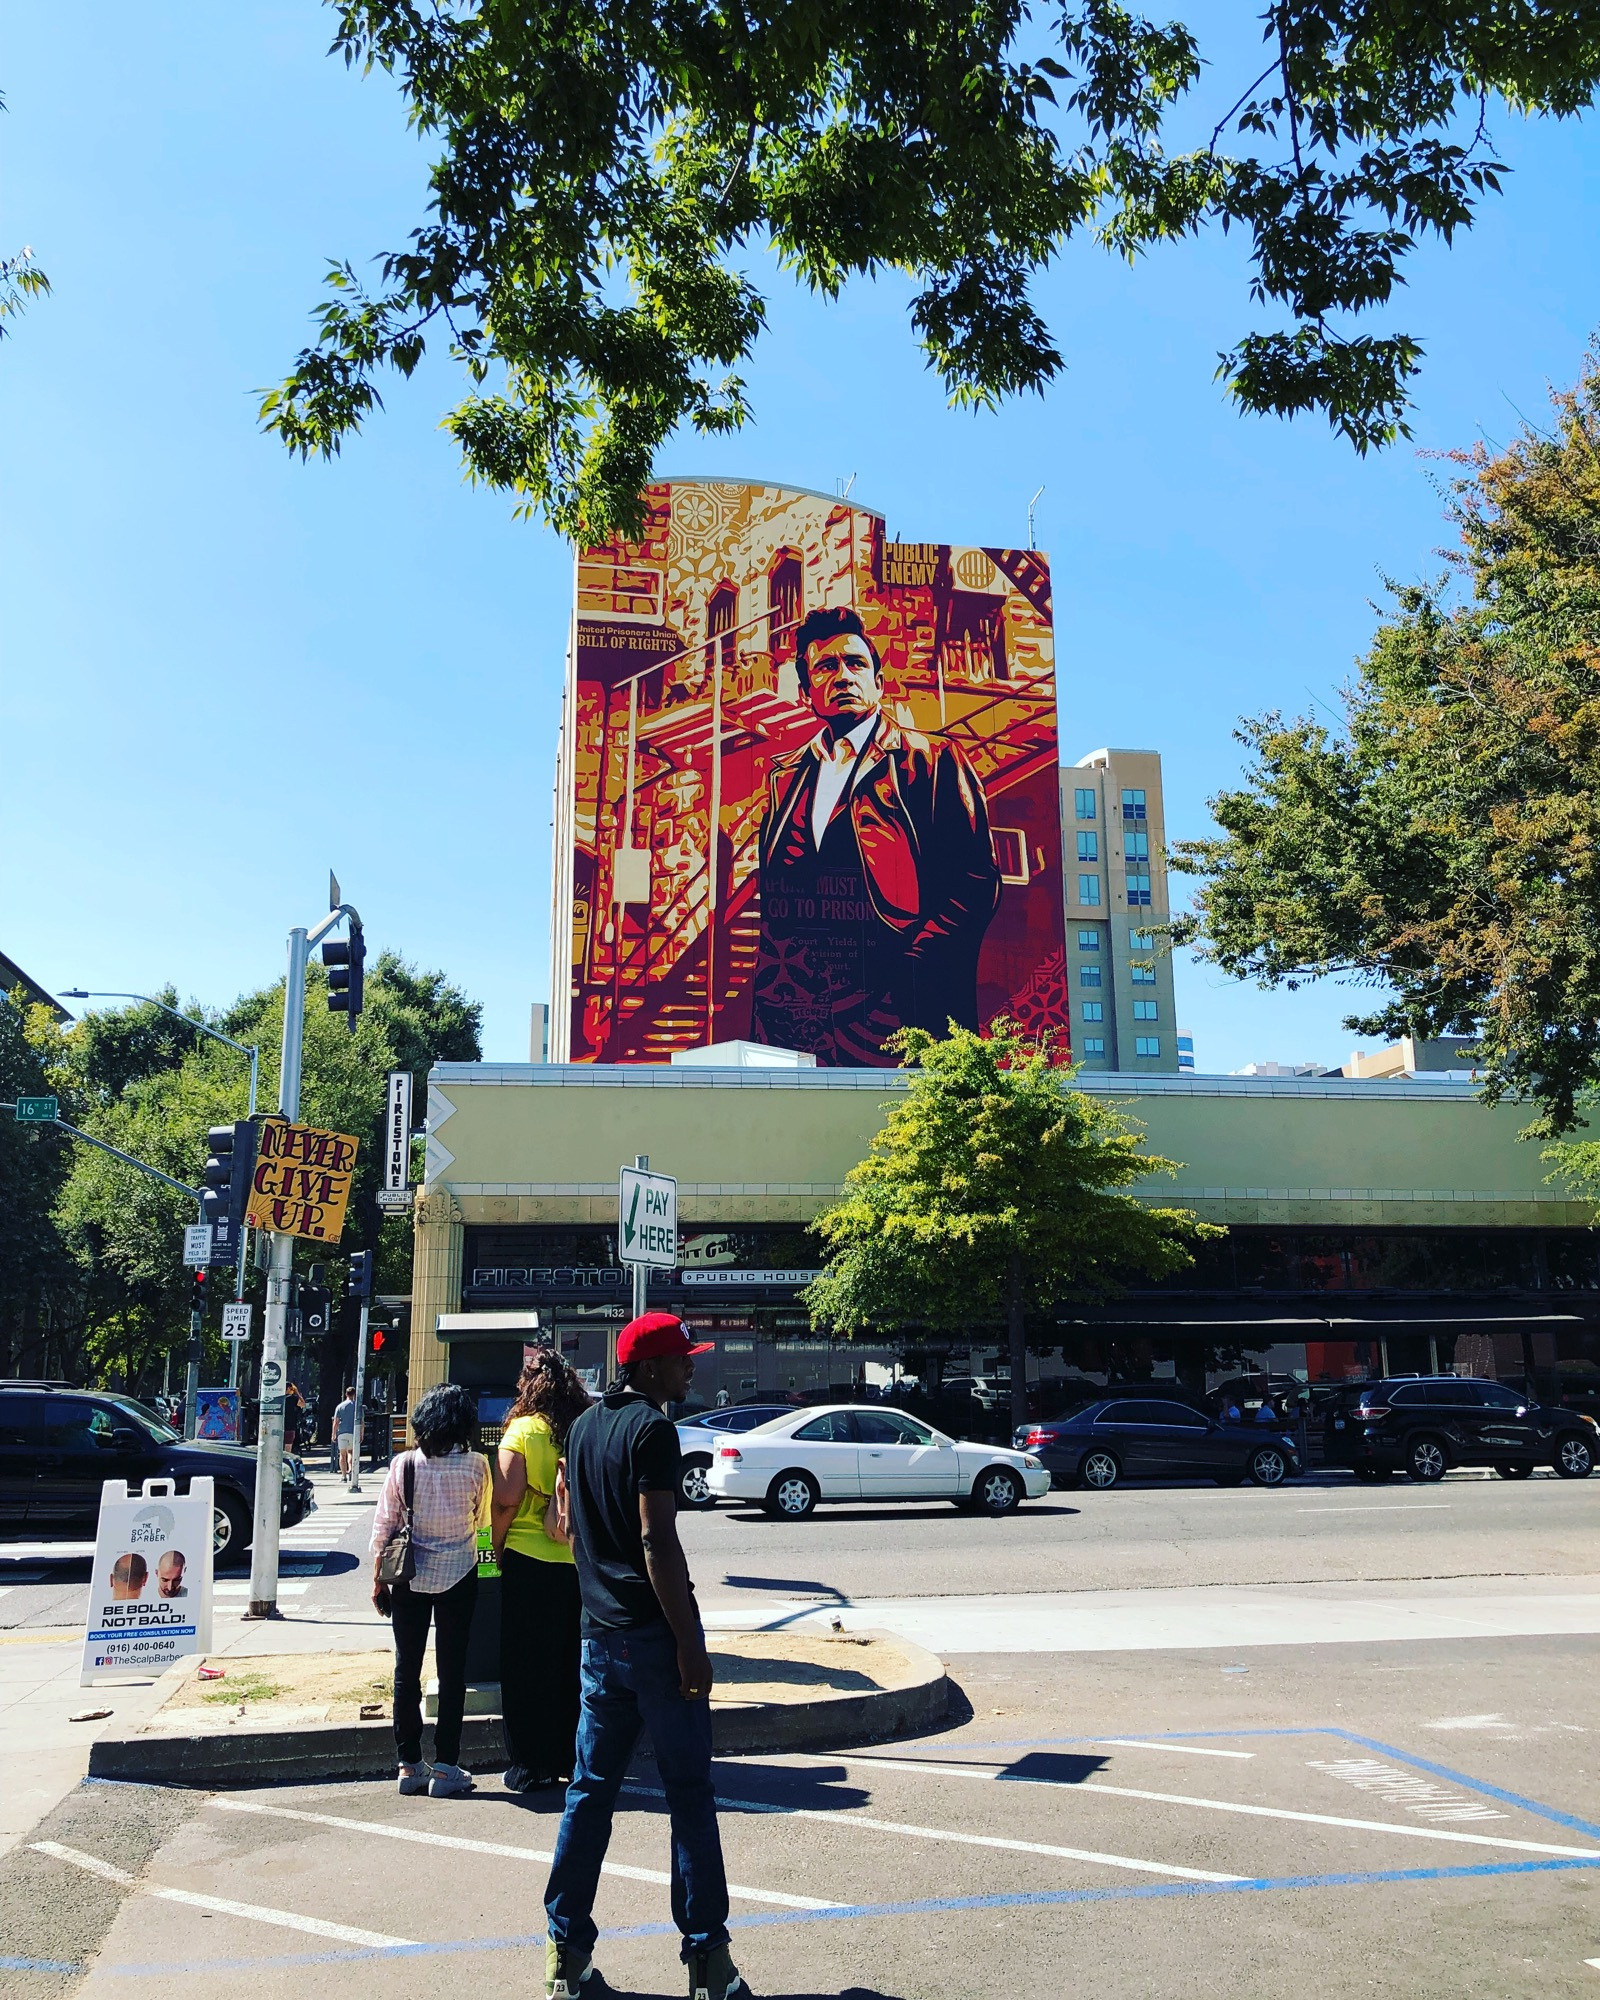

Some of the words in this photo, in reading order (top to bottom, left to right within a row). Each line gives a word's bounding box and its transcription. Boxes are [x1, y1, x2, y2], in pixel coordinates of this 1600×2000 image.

[882, 539, 939, 564] PUBLIC
[882, 561, 937, 586] ENEMY
[577, 625, 606, 634] United
[607, 627, 650, 637] Prisoners
[652, 630, 677, 639] Union
[578, 634, 607, 648] BILL
[610, 636, 626, 649] OF
[628, 637, 676, 652] RIGHTS
[816, 876, 857, 897] MUST
[767, 898, 789, 918] GO
[795, 899, 815, 919] TO
[821, 899, 875, 921] PRISON
[391, 1079, 403, 1187] FIRESTONE
[258, 1123, 354, 1172] NEVER
[254, 1162, 347, 1205] GIVE
[646, 1188, 669, 1217] PAY
[270, 1198, 325, 1237] UP.
[640, 1223, 674, 1254] HERE
[695, 1273, 756, 1282] PUBLIC
[226, 1307, 249, 1315] SPEED
[224, 1323, 247, 1337] 25
[103, 1606, 124, 1616] BE
[126, 1603, 174, 1615] BOLD,
[101, 1618, 137, 1628] NOT
[138, 1614, 186, 1626] BALD!
[138, 1629, 181, 1637] CONSULTATION
[106, 1644, 131, 1655] (916)
[132, 1640, 176, 1652] 400-0640
[1304, 1758, 1465, 1802] PARKING
[1404, 1803, 1511, 1823] NO
[556, 1984, 565, 1992] 23
[697, 1992, 706, 2000] 23
